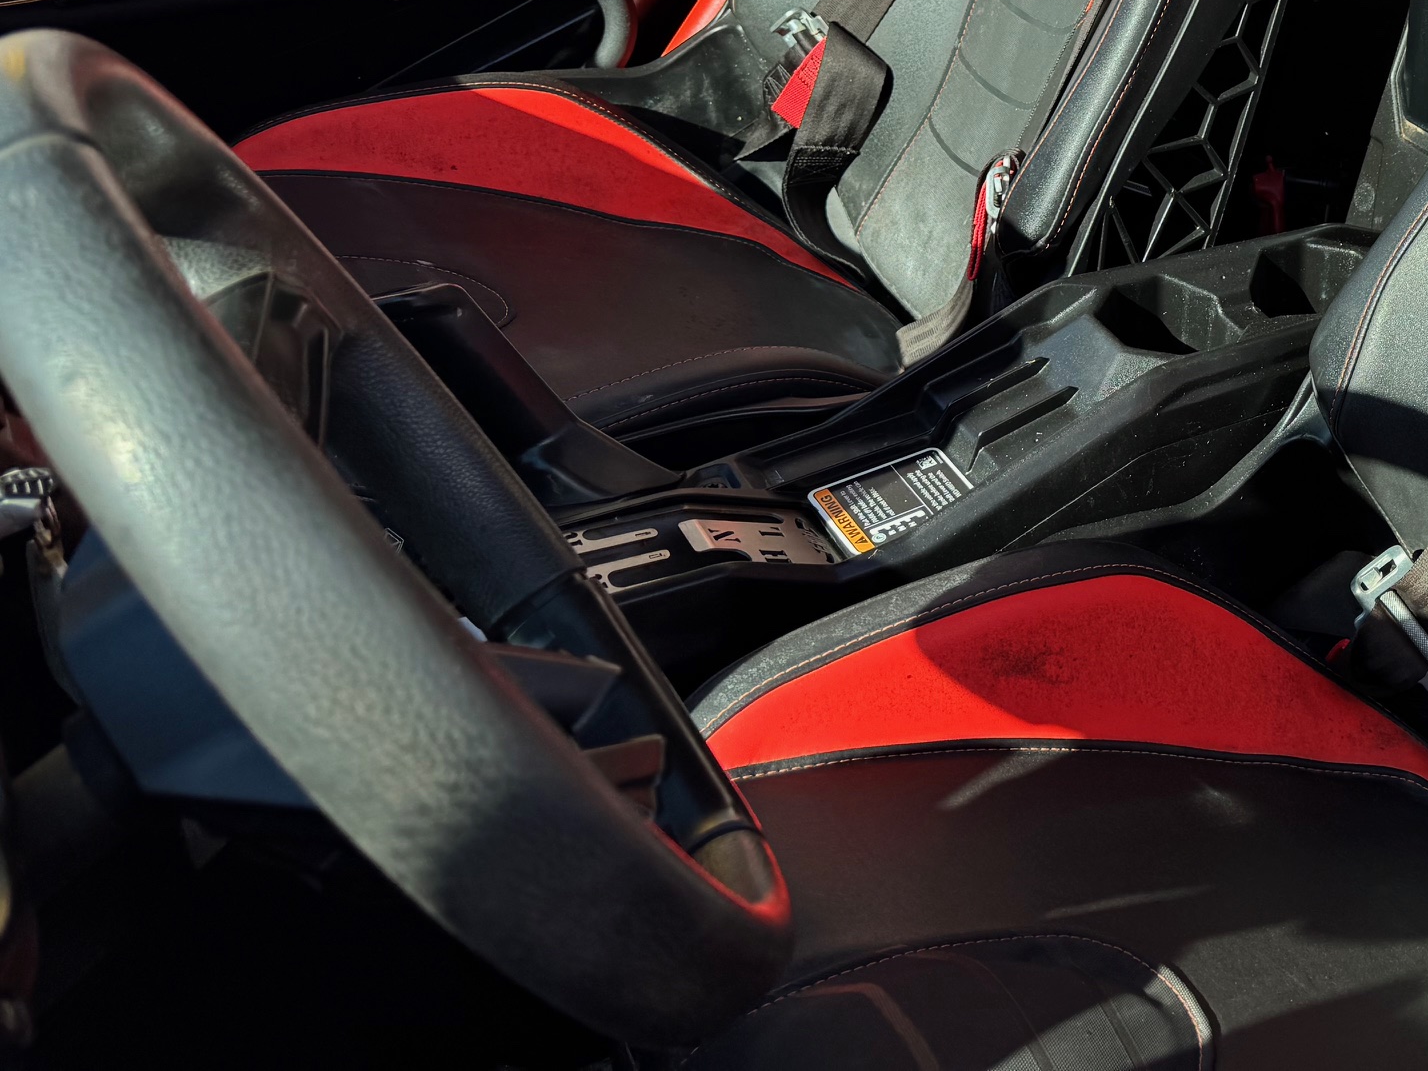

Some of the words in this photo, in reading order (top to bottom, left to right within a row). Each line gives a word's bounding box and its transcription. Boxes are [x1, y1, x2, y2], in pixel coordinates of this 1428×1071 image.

[819, 494, 861, 538] WARNING
[708, 529, 741, 542] N
[759, 527, 784, 537] L
